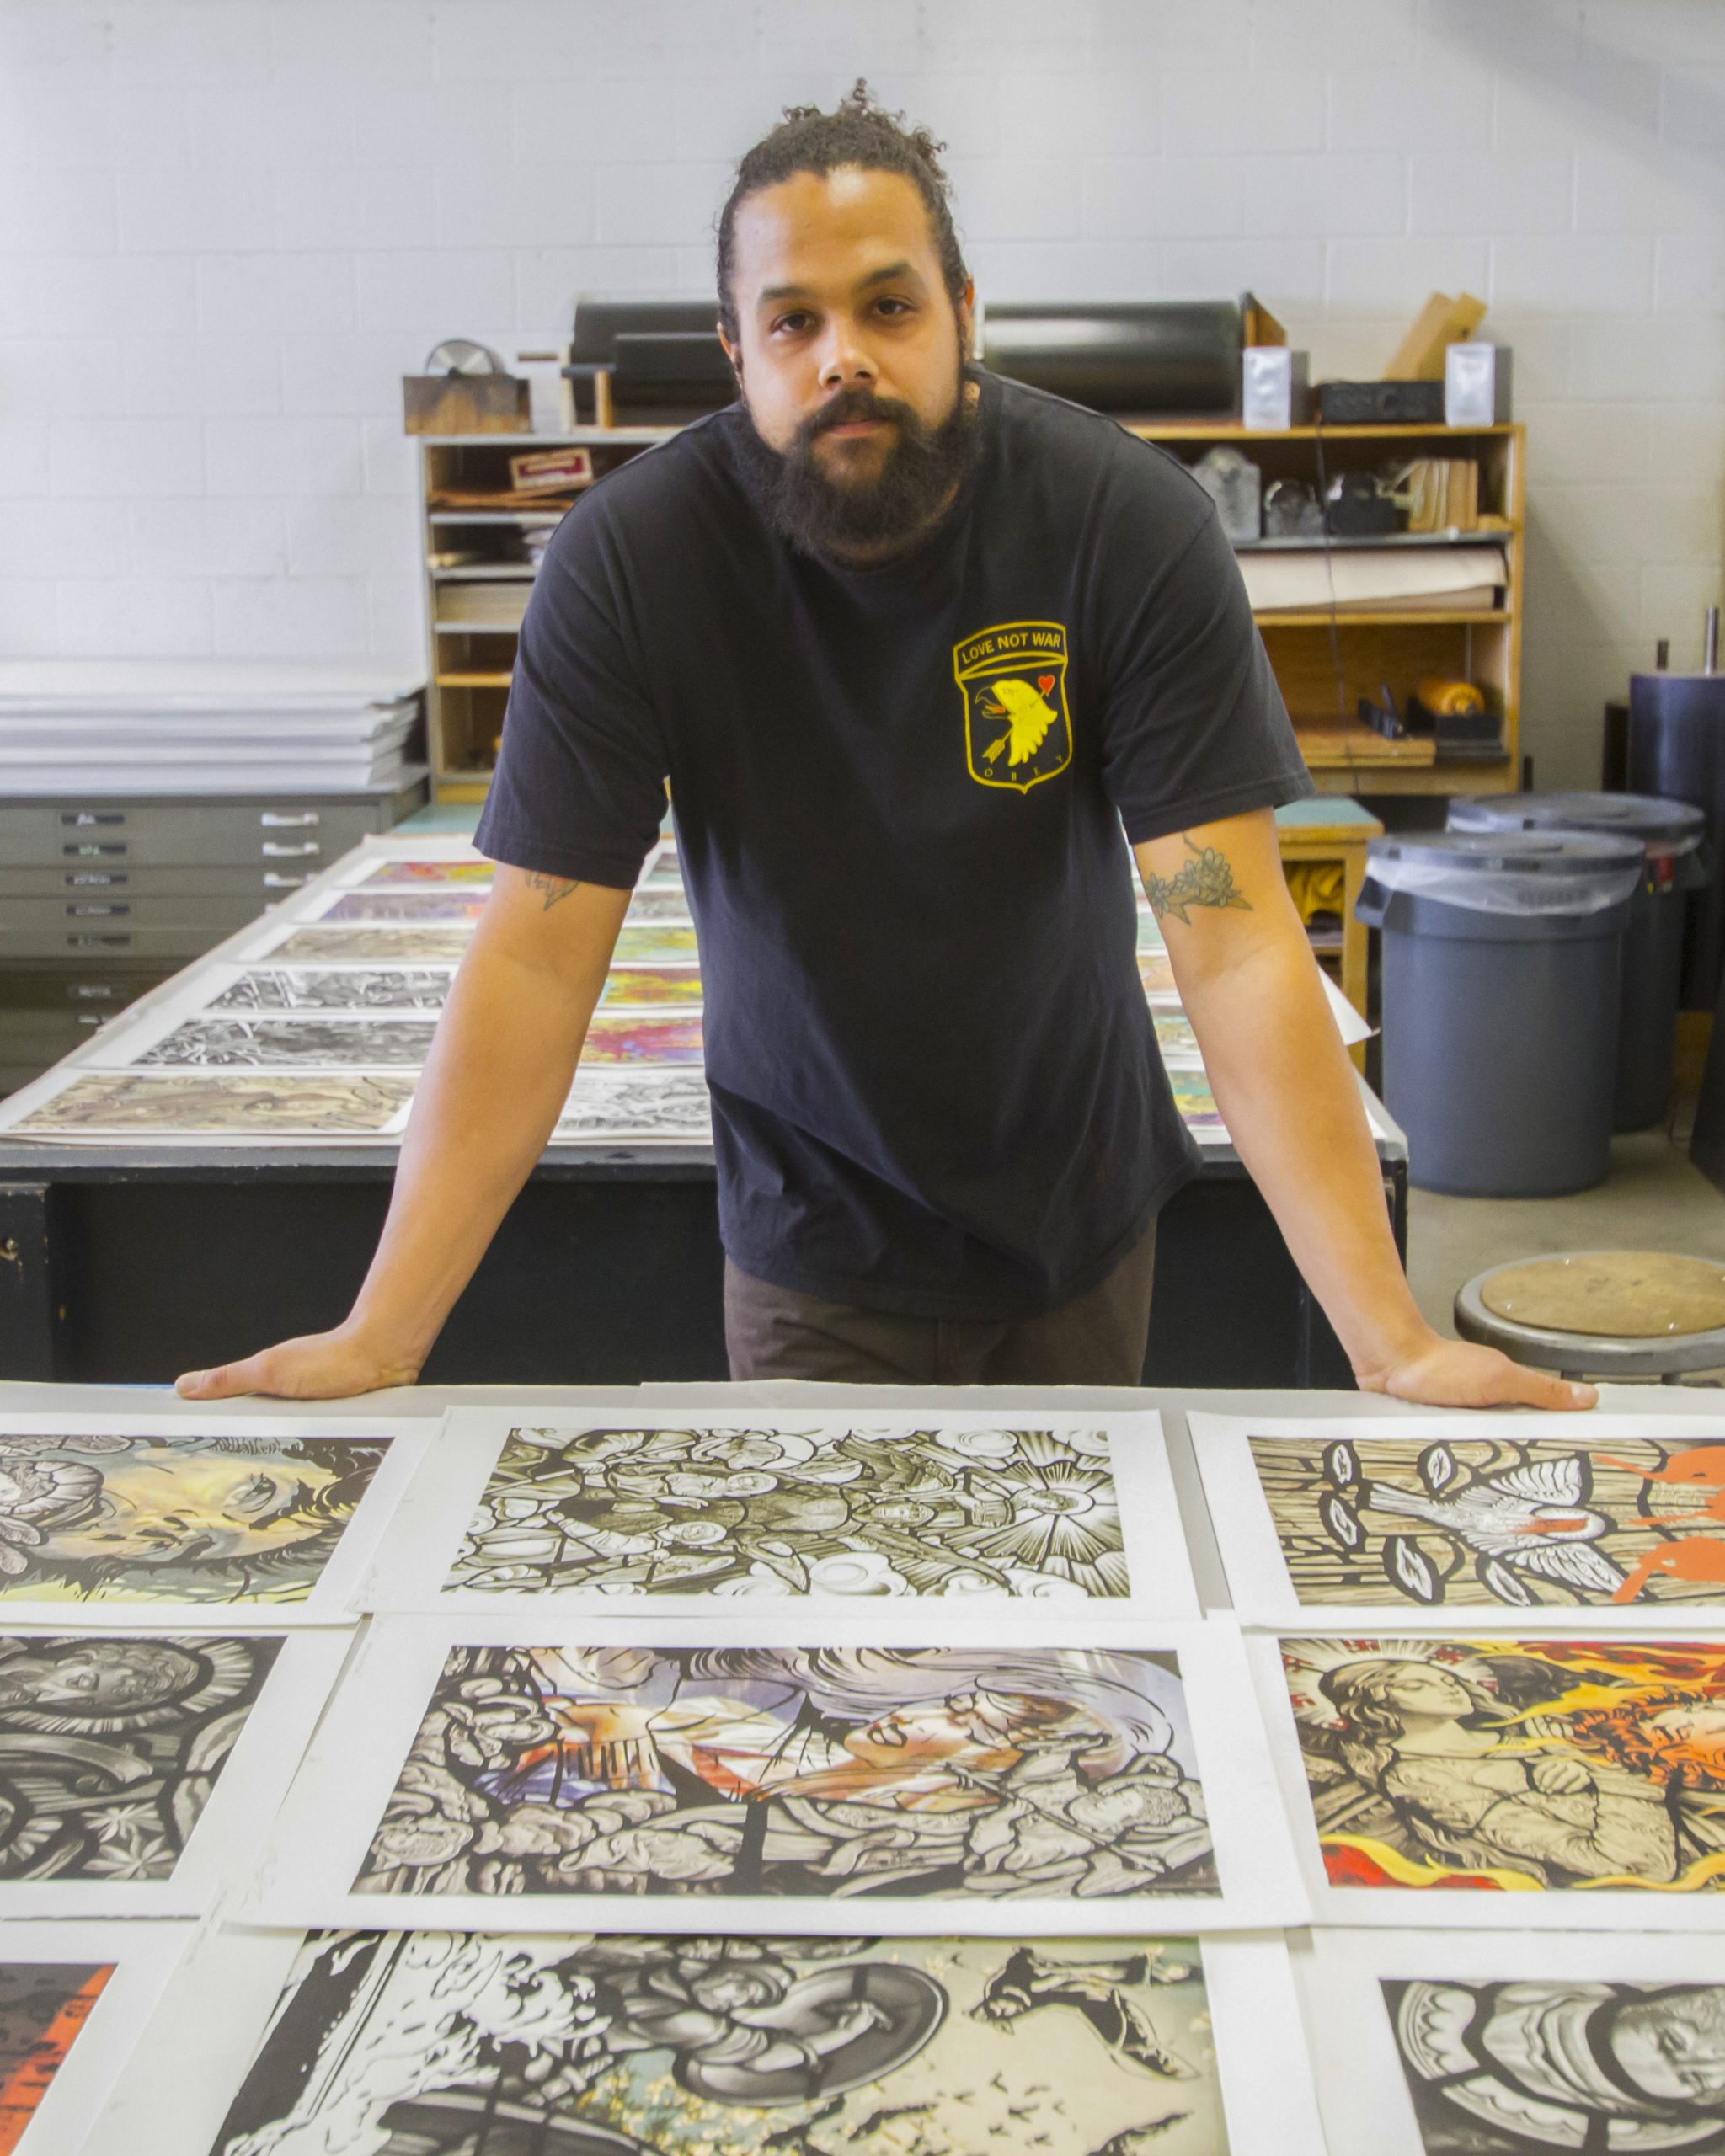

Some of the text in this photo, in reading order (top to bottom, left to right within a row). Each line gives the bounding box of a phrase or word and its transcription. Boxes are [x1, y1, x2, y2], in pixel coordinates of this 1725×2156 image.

[962, 632, 1061, 664] LOVE NOT WAR
